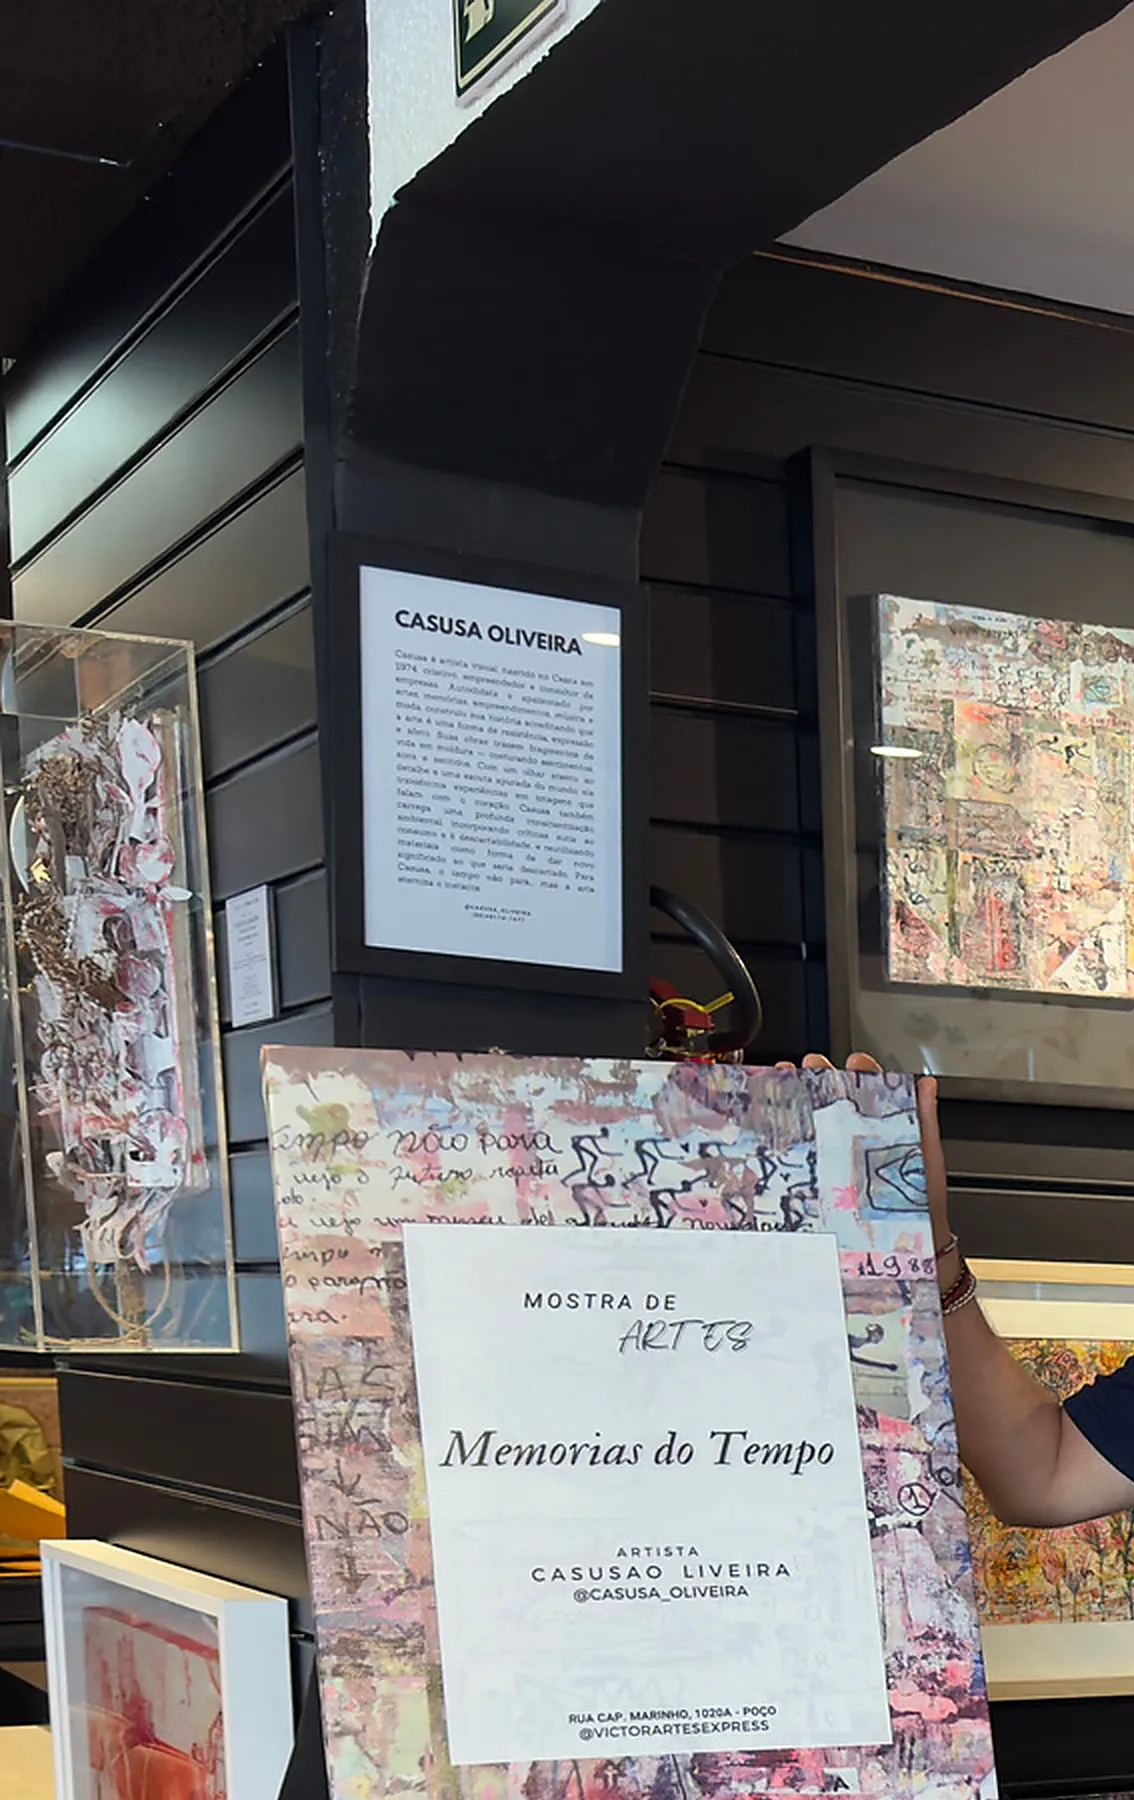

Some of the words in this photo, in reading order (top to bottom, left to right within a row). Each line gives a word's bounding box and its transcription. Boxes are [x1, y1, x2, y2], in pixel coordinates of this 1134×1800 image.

[395, 609, 483, 640] CASUSA
[487, 624, 582, 656] OLIVEIRA
[387, 1123, 468, 1157] não
[479, 1131, 563, 1155] para
[523, 1292, 632, 1310] MOSTRA
[645, 1294, 677, 1311] DE
[618, 1319, 755, 1354] ARTES
[439, 1430, 643, 1468] Memorias
[653, 1431, 695, 1467] do
[709, 1430, 836, 1476] Tempo
[616, 1546, 699, 1559] ARTISTA
[531, 1564, 663, 1583] CASUSAO
[683, 1563, 791, 1579] LIVEIRA
[573, 1585, 749, 1603] @CASUSA_OLIVEIRA
[568, 1712, 595, 1725] RUA
[597, 1711, 627, 1724] CAP.
[629, 1708, 693, 1722] MARINHO,
[694, 1706, 733, 1720] 1020A
[742, 1705, 777, 1719] POÇO
[579, 1719, 770, 1741] @VICTORARTESEXPRESS
